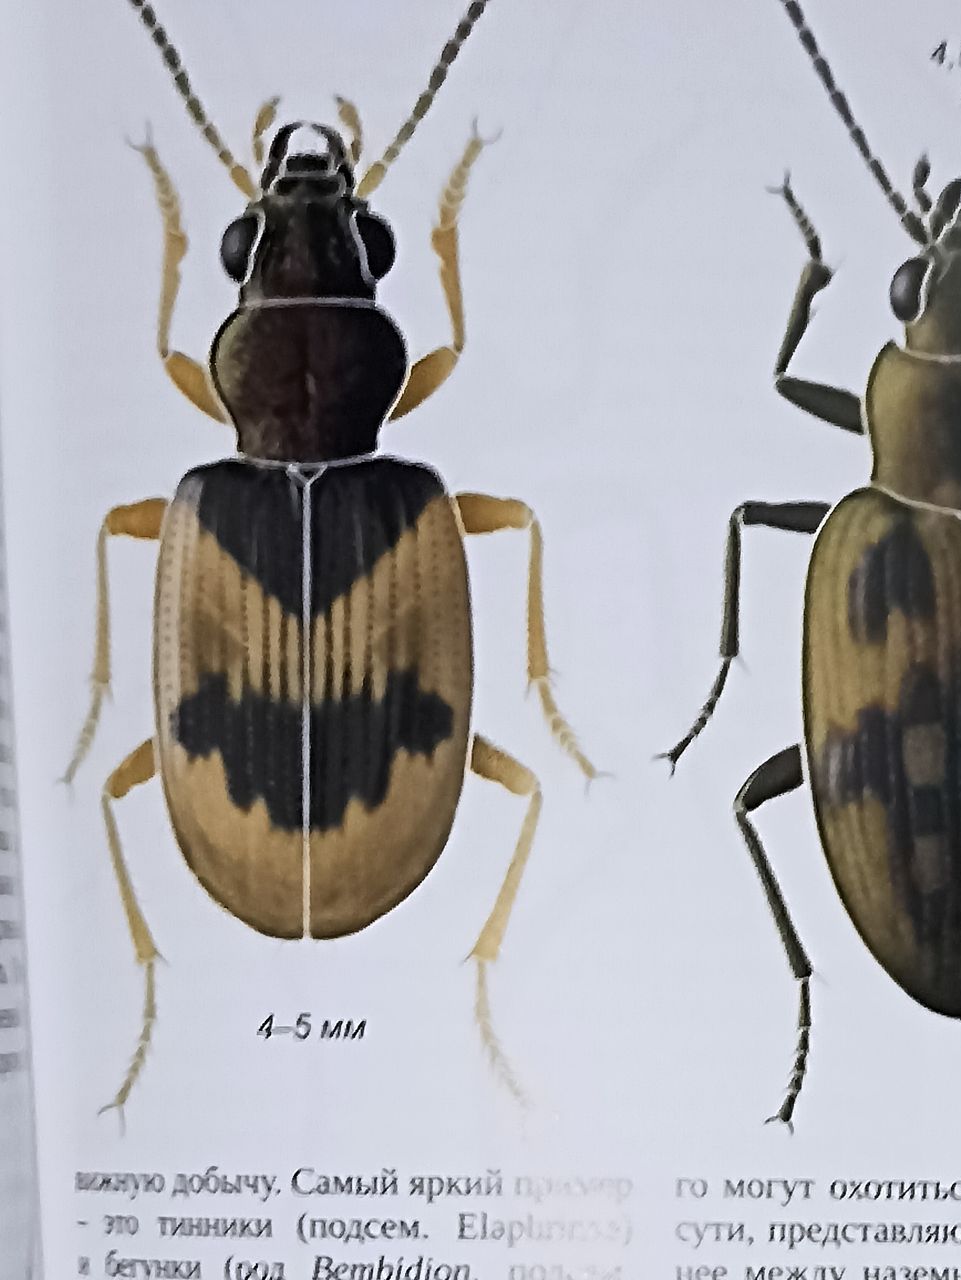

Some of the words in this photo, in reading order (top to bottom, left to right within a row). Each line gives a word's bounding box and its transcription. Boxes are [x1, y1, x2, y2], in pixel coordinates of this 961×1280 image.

[319, 1018, 368, 1041] мм
[170, 1164, 282, 1203] добычу.
[290, 1166, 399, 1197] Самый
[408, 1168, 503, 1205] яркий
[676, 1177, 709, 1199] го
[723, 1177, 816, 1208] могут
[675, 1221, 755, 1249] сути,
